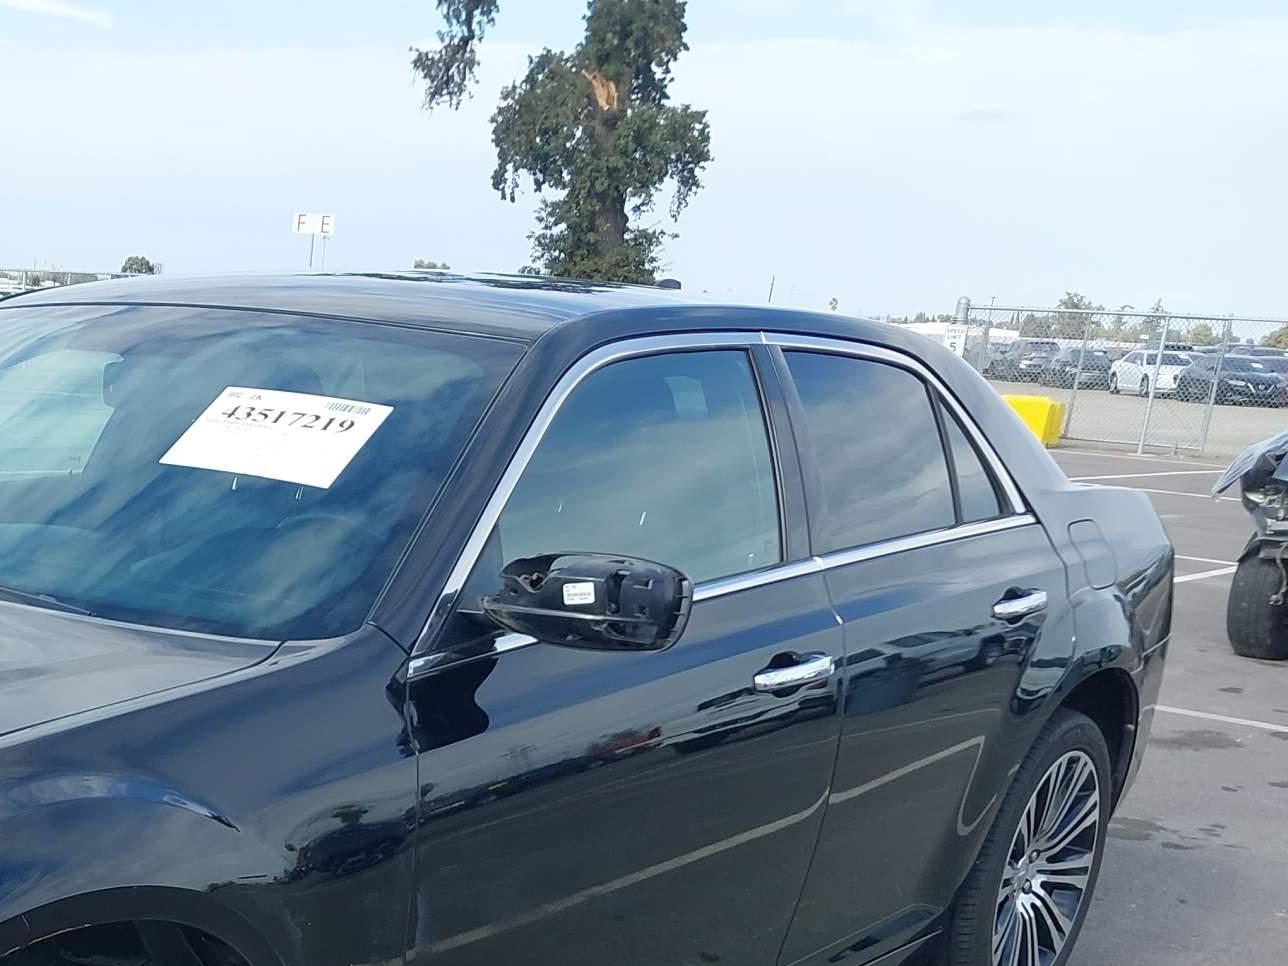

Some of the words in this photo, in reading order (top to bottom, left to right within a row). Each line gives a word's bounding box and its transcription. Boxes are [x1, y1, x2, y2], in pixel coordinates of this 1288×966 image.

[297, 214, 307, 232] F
[321, 215, 331, 234] E
[949, 342, 957, 352] 5
[222, 404, 355, 433] 43517219
